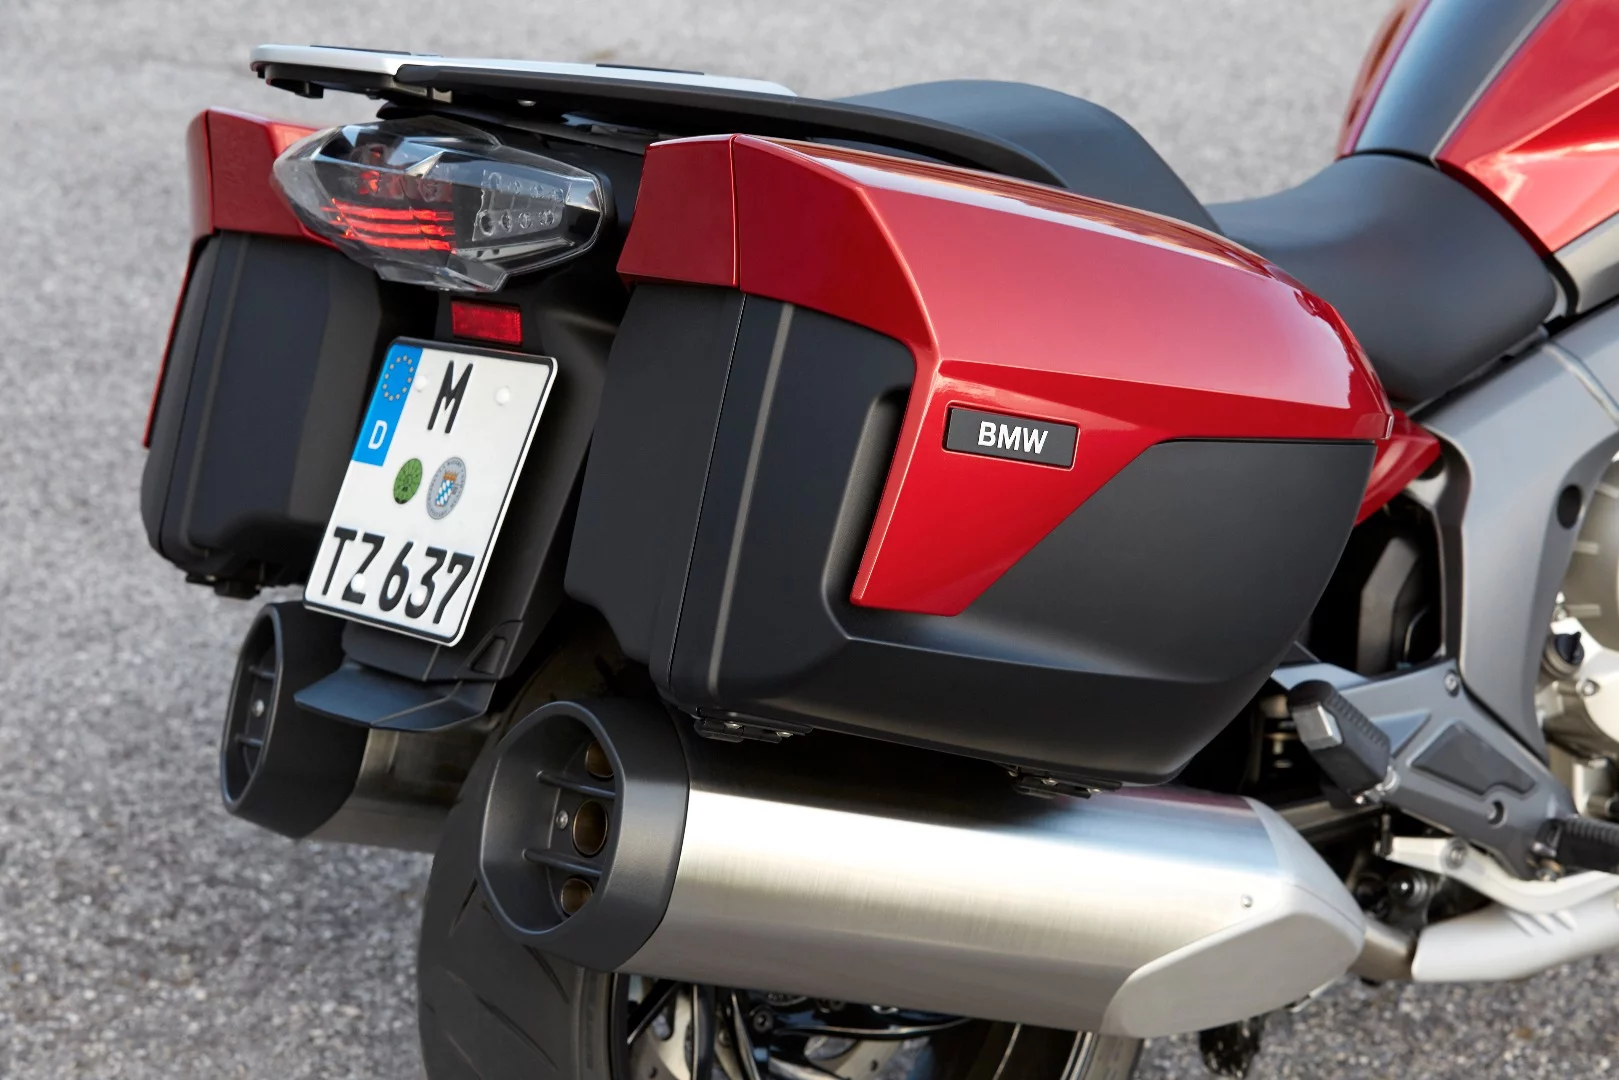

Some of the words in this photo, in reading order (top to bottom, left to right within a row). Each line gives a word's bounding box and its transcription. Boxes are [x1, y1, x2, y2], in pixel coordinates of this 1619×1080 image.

[427, 360, 474, 434] M
[368, 420, 388, 450] D
[978, 421, 1049, 454] BMW
[321, 526, 386, 605] TZ
[378, 541, 475, 625] 637
